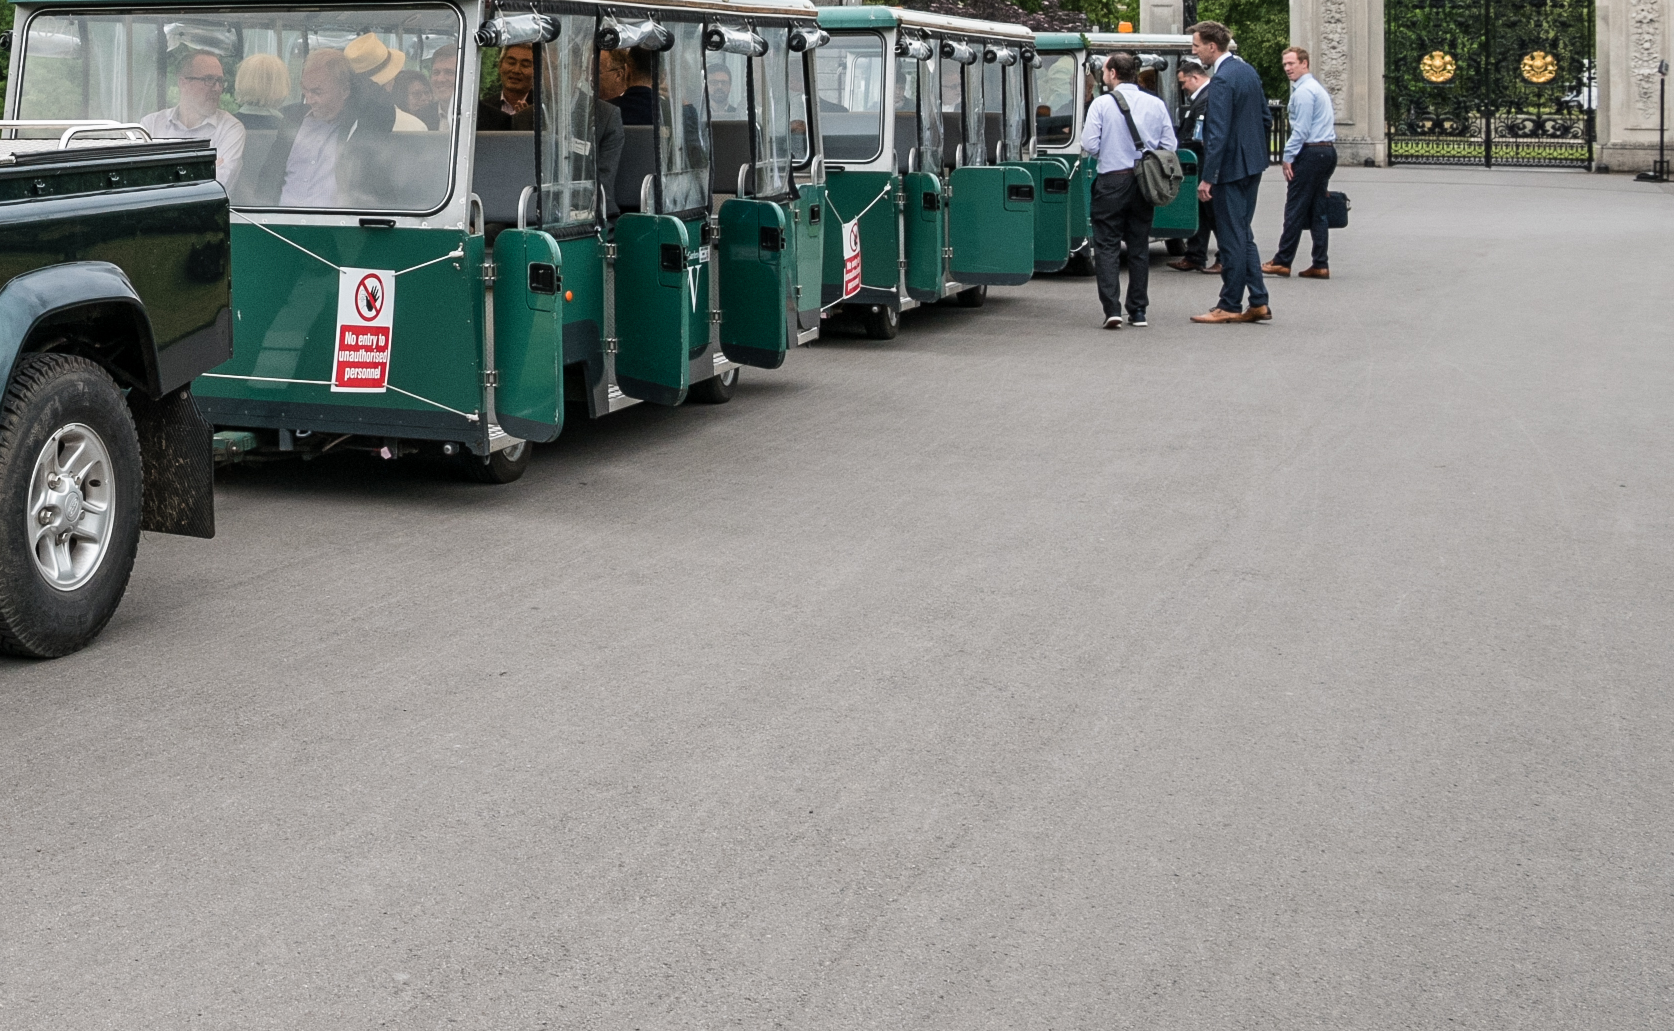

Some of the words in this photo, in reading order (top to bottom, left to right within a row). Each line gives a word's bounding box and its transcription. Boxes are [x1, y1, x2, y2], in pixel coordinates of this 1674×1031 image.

[344, 331, 356, 345] No
[358, 333, 377, 349] entry
[378, 333, 386, 346] to
[338, 349, 388, 363] unauthorised
[344, 366, 381, 381] personnel
